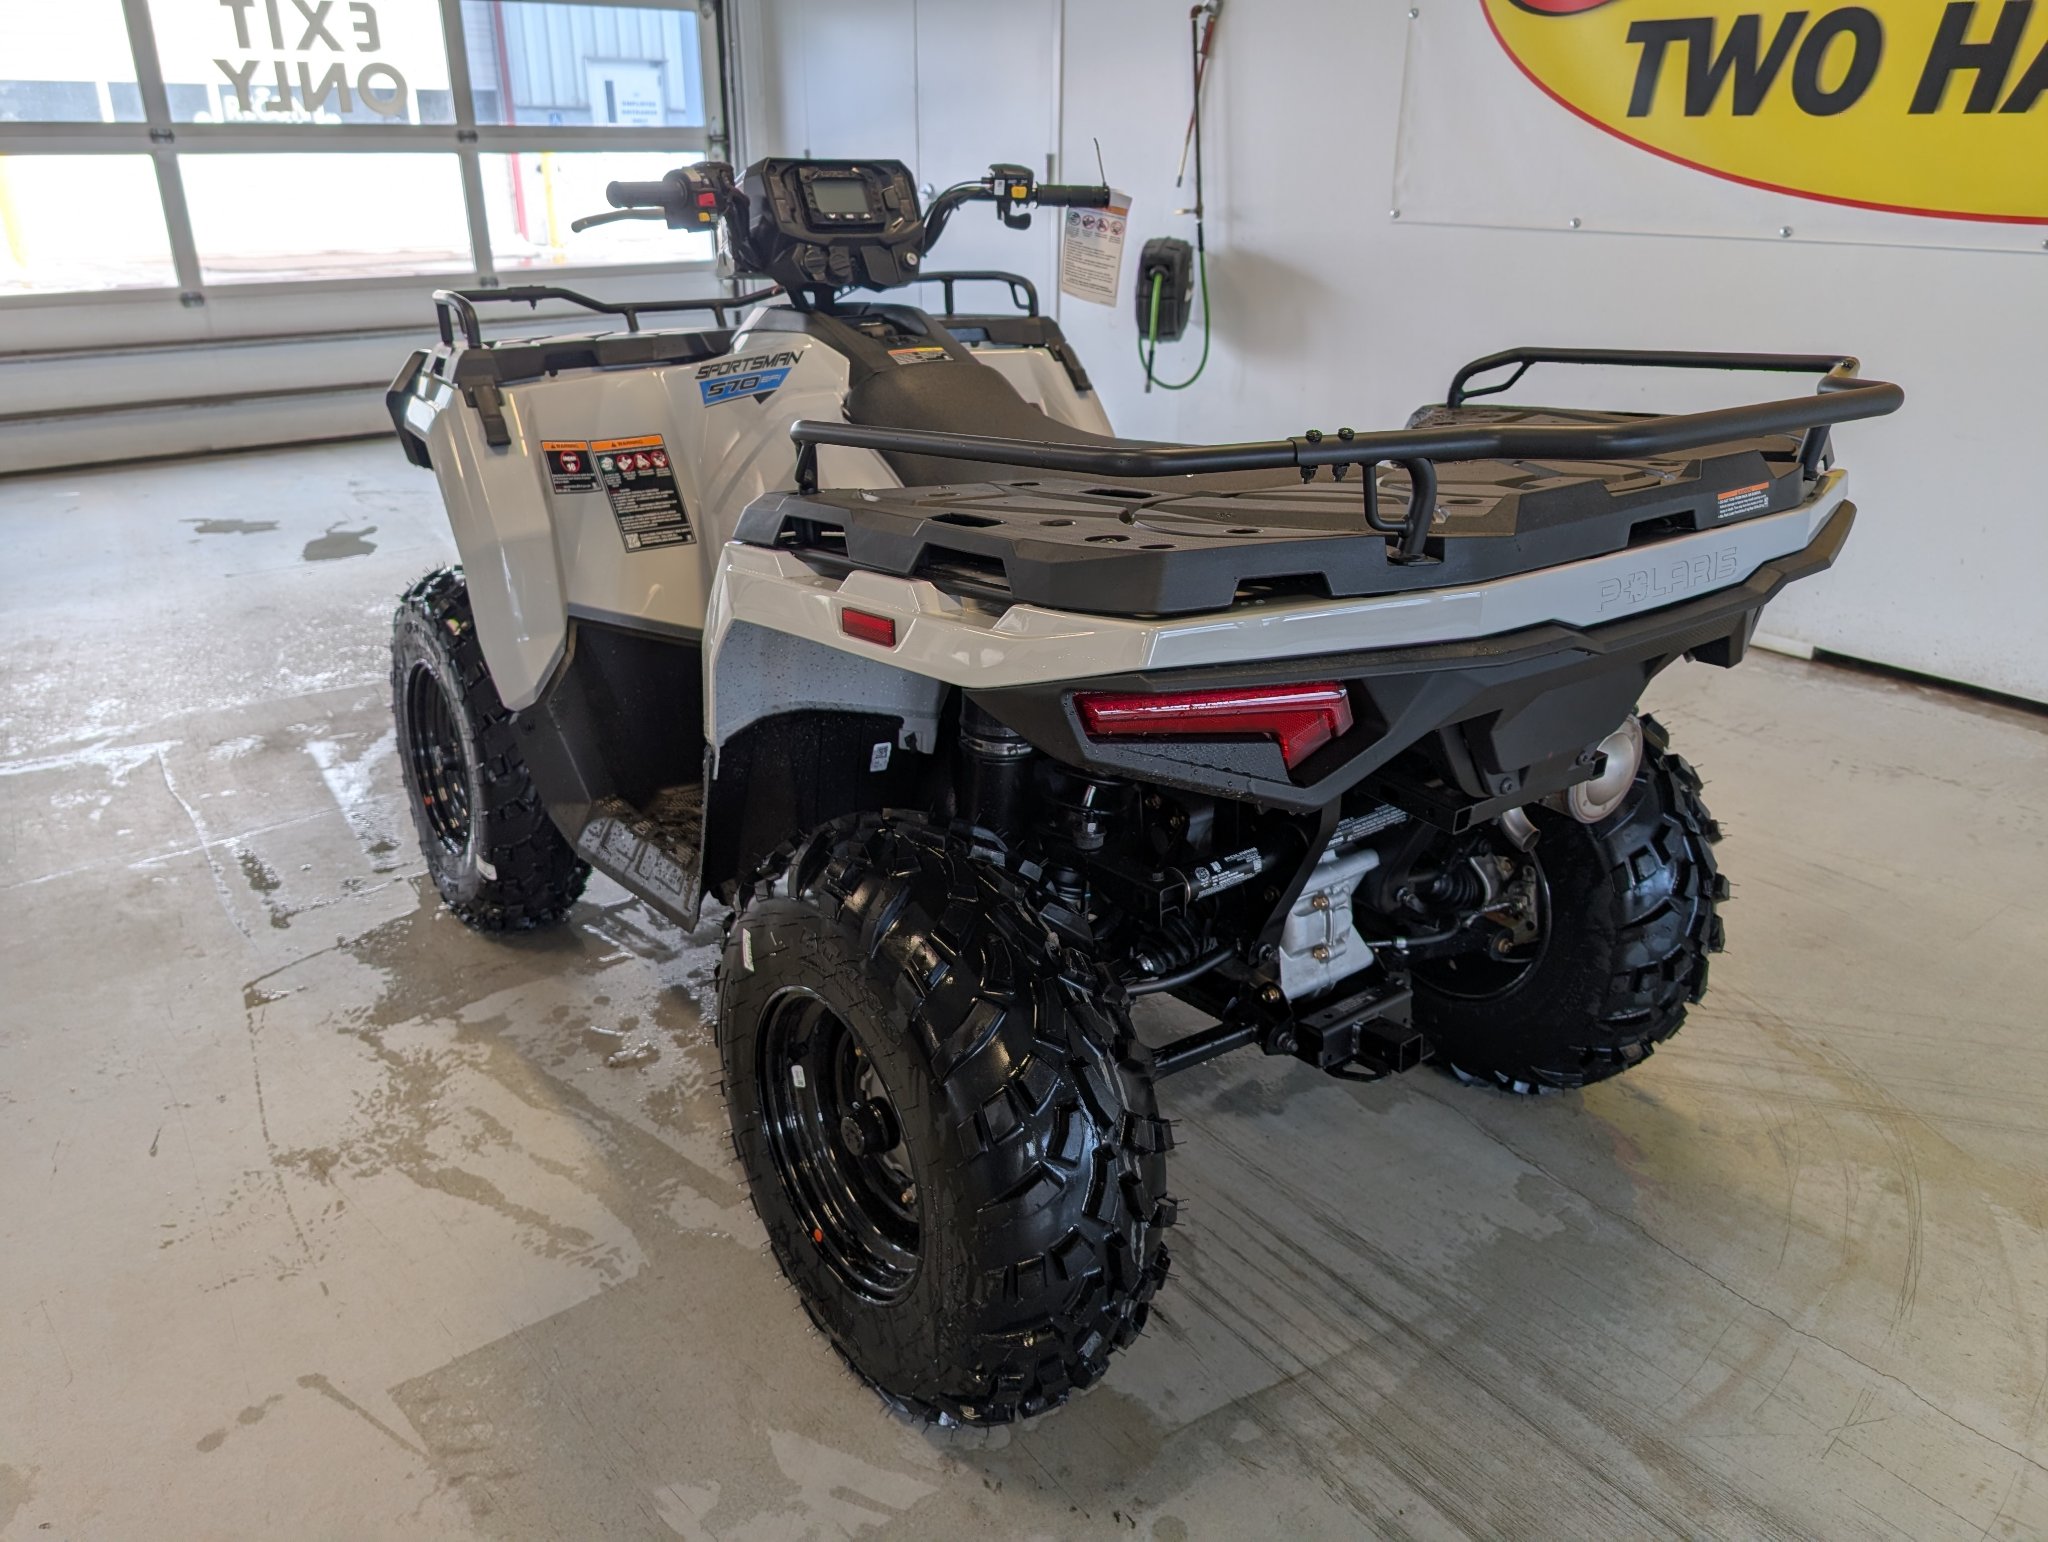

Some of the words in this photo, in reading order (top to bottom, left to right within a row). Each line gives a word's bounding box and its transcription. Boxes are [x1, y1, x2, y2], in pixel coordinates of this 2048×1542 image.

[1625, 7, 1882, 118] TWO
[695, 350, 804, 380] SPORTSMAN
[706, 375, 761, 398] 570
[1597, 546, 1738, 613] POLARIS
